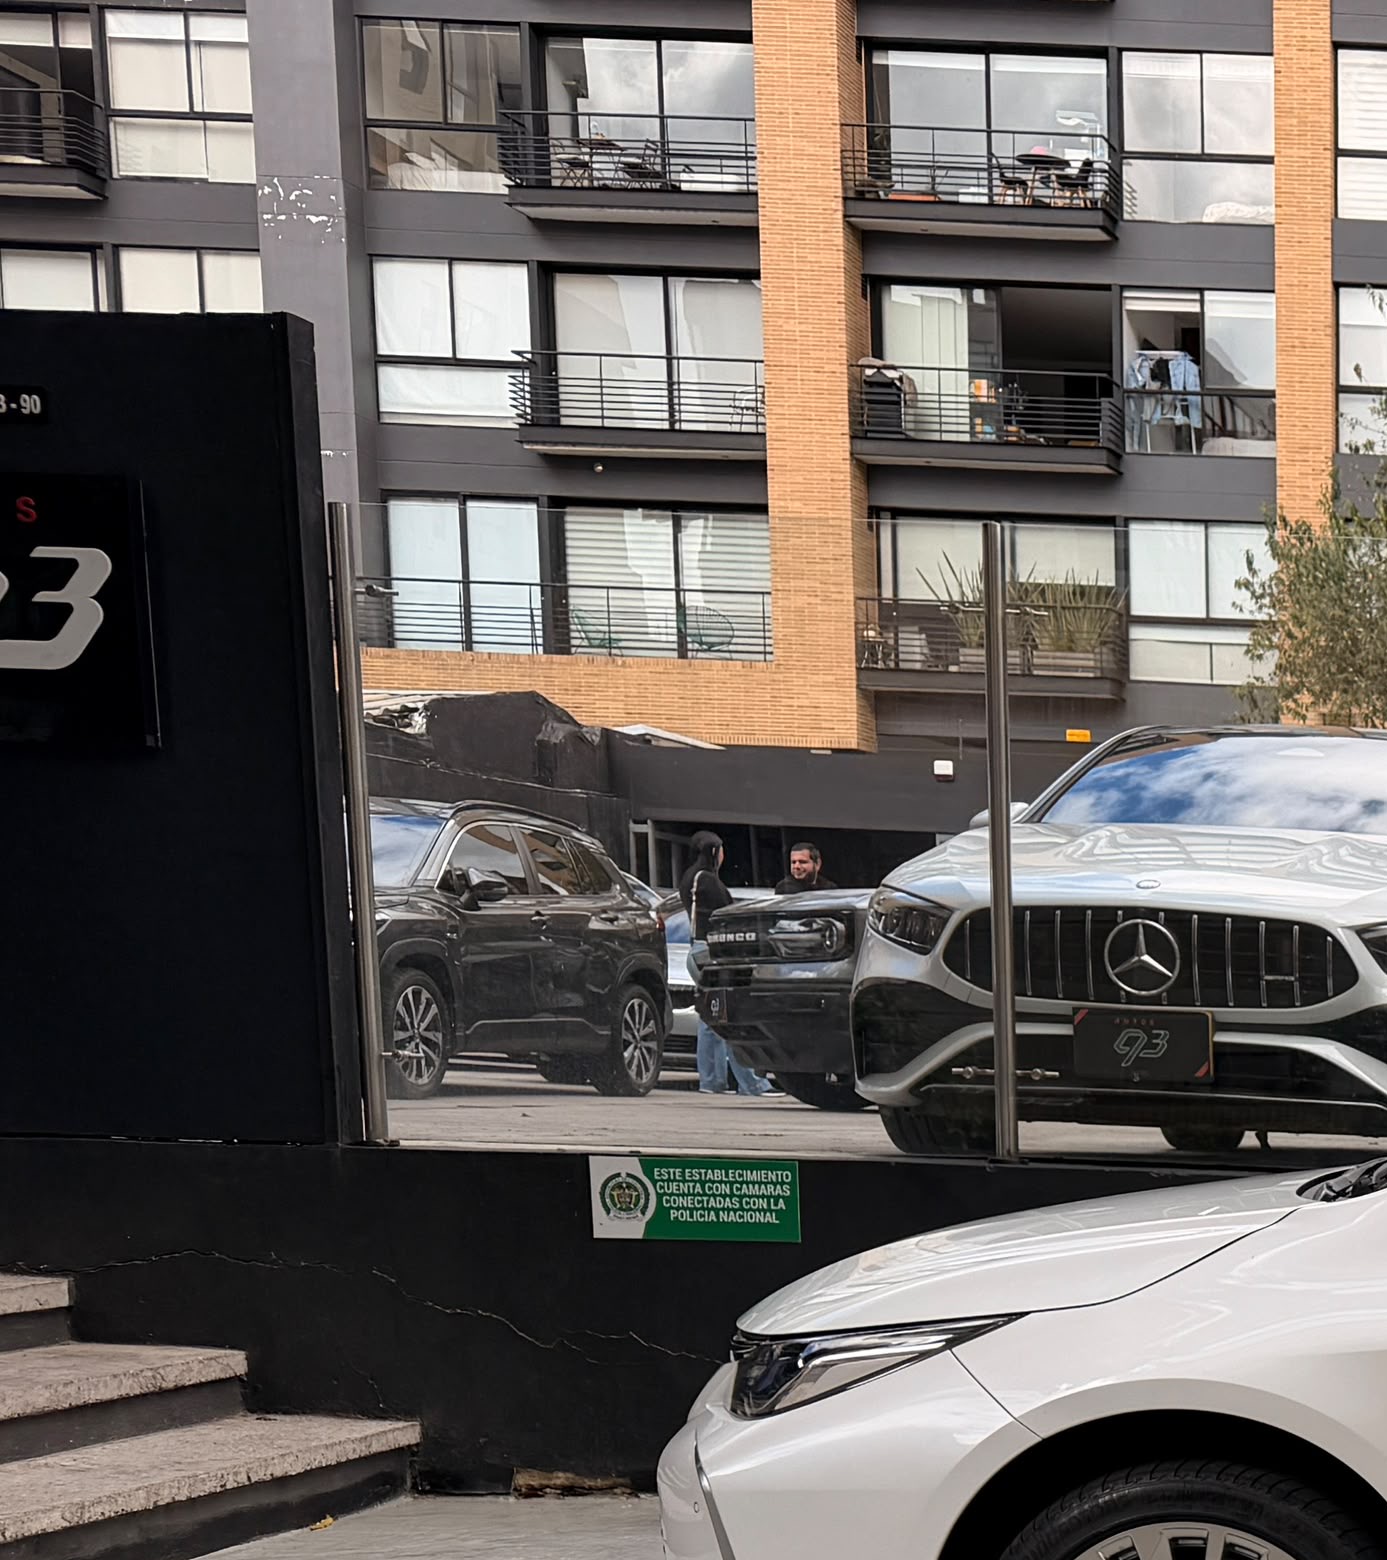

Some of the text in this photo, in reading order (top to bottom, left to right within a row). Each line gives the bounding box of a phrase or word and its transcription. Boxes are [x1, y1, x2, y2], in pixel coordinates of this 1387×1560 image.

[1113, 1028, 1170, 1067] 93
[653, 1167, 792, 1183] ESTE ESTABLECIMIENTO
[656, 1181, 791, 1196] CUENTA CON CAMARAS
[662, 1195, 787, 1210] CONECTADAS CON LA
[670, 1208, 781, 1224] POLICIA NACIONAL
